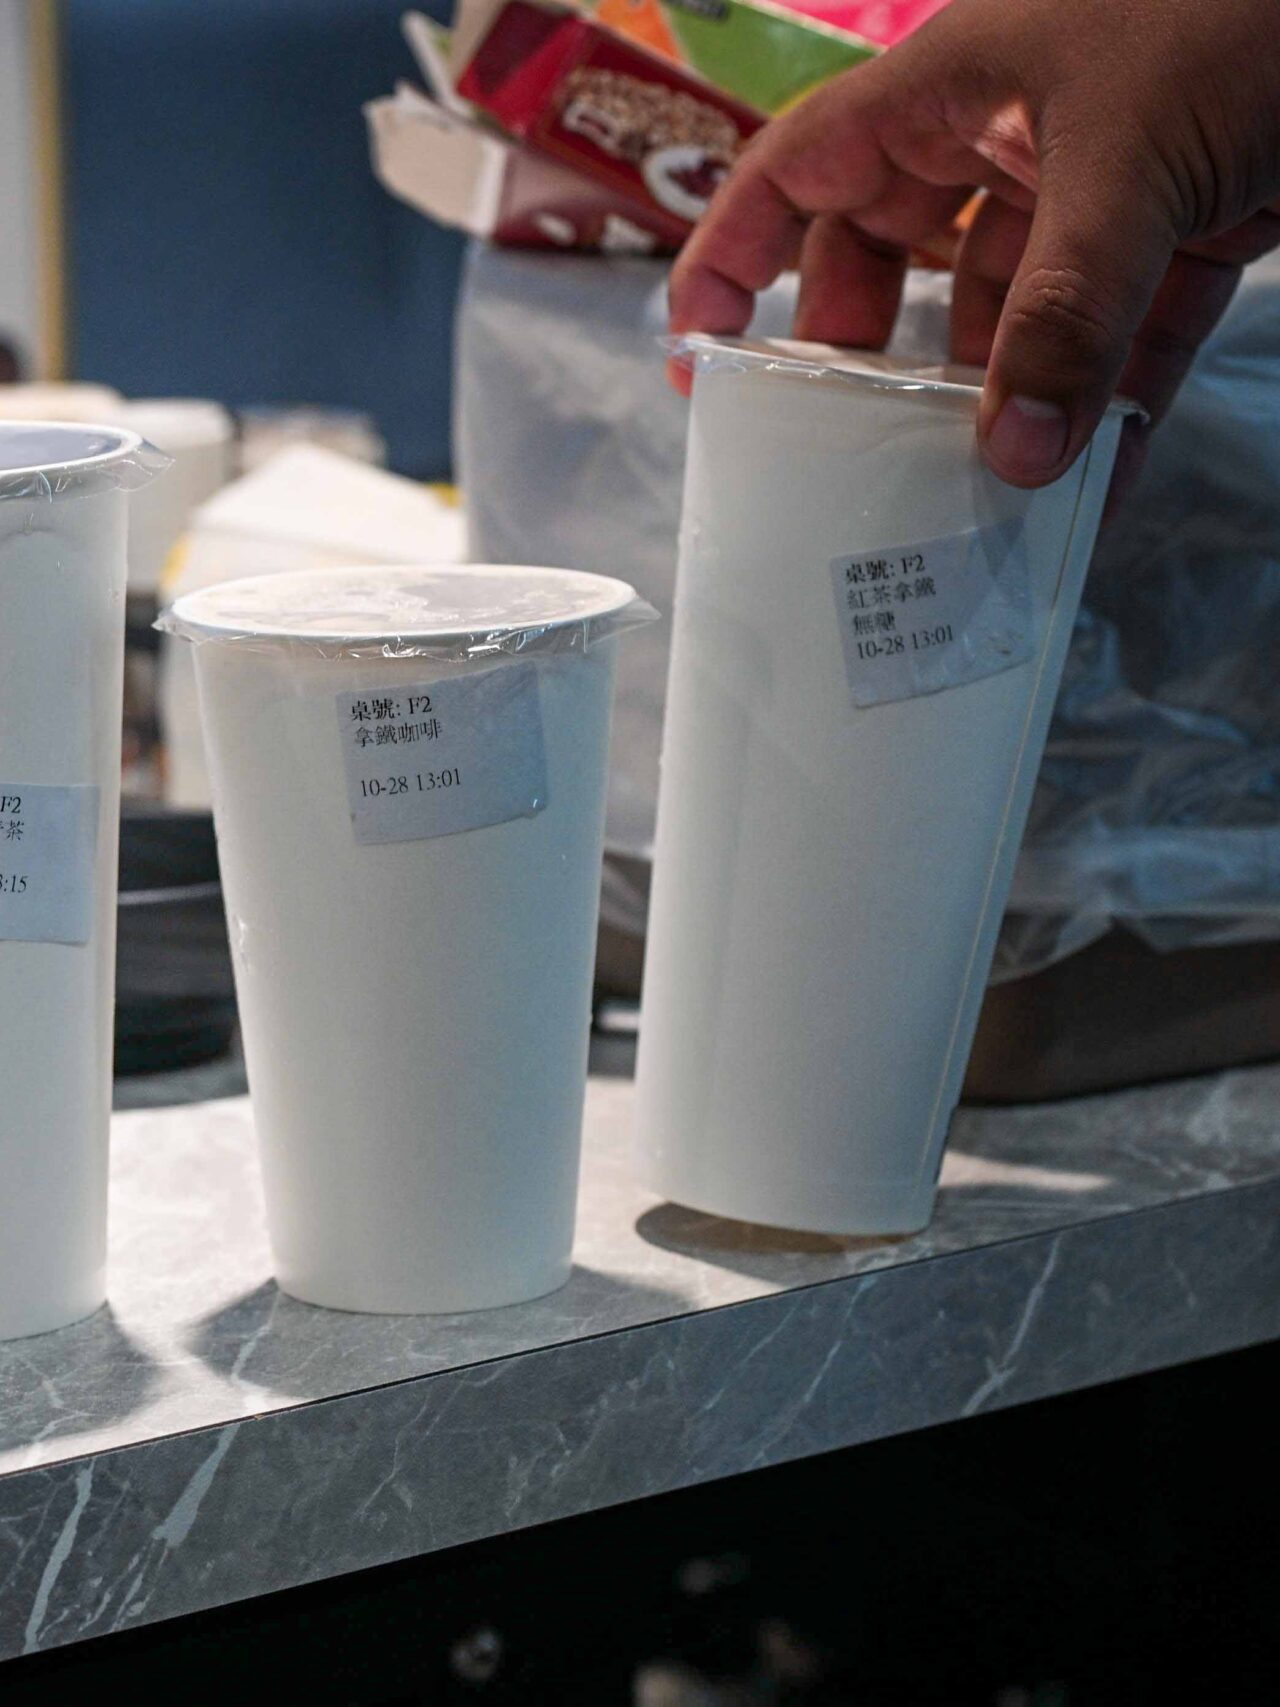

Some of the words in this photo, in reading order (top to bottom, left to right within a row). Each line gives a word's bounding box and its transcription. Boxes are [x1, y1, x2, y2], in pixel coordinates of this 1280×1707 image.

[901, 554, 925, 574] F2
[857, 635, 904, 659] 10-28
[911, 624, 954, 650] 13:01
[350, 698, 401, 721] 桌號:
[408, 696, 432, 715] F2
[354, 718, 443, 747] 拿鐵咖啡
[360, 775, 408, 797] 10-28
[416, 768, 461, 791] 13:01
[0, 796, 22, 813] F2
